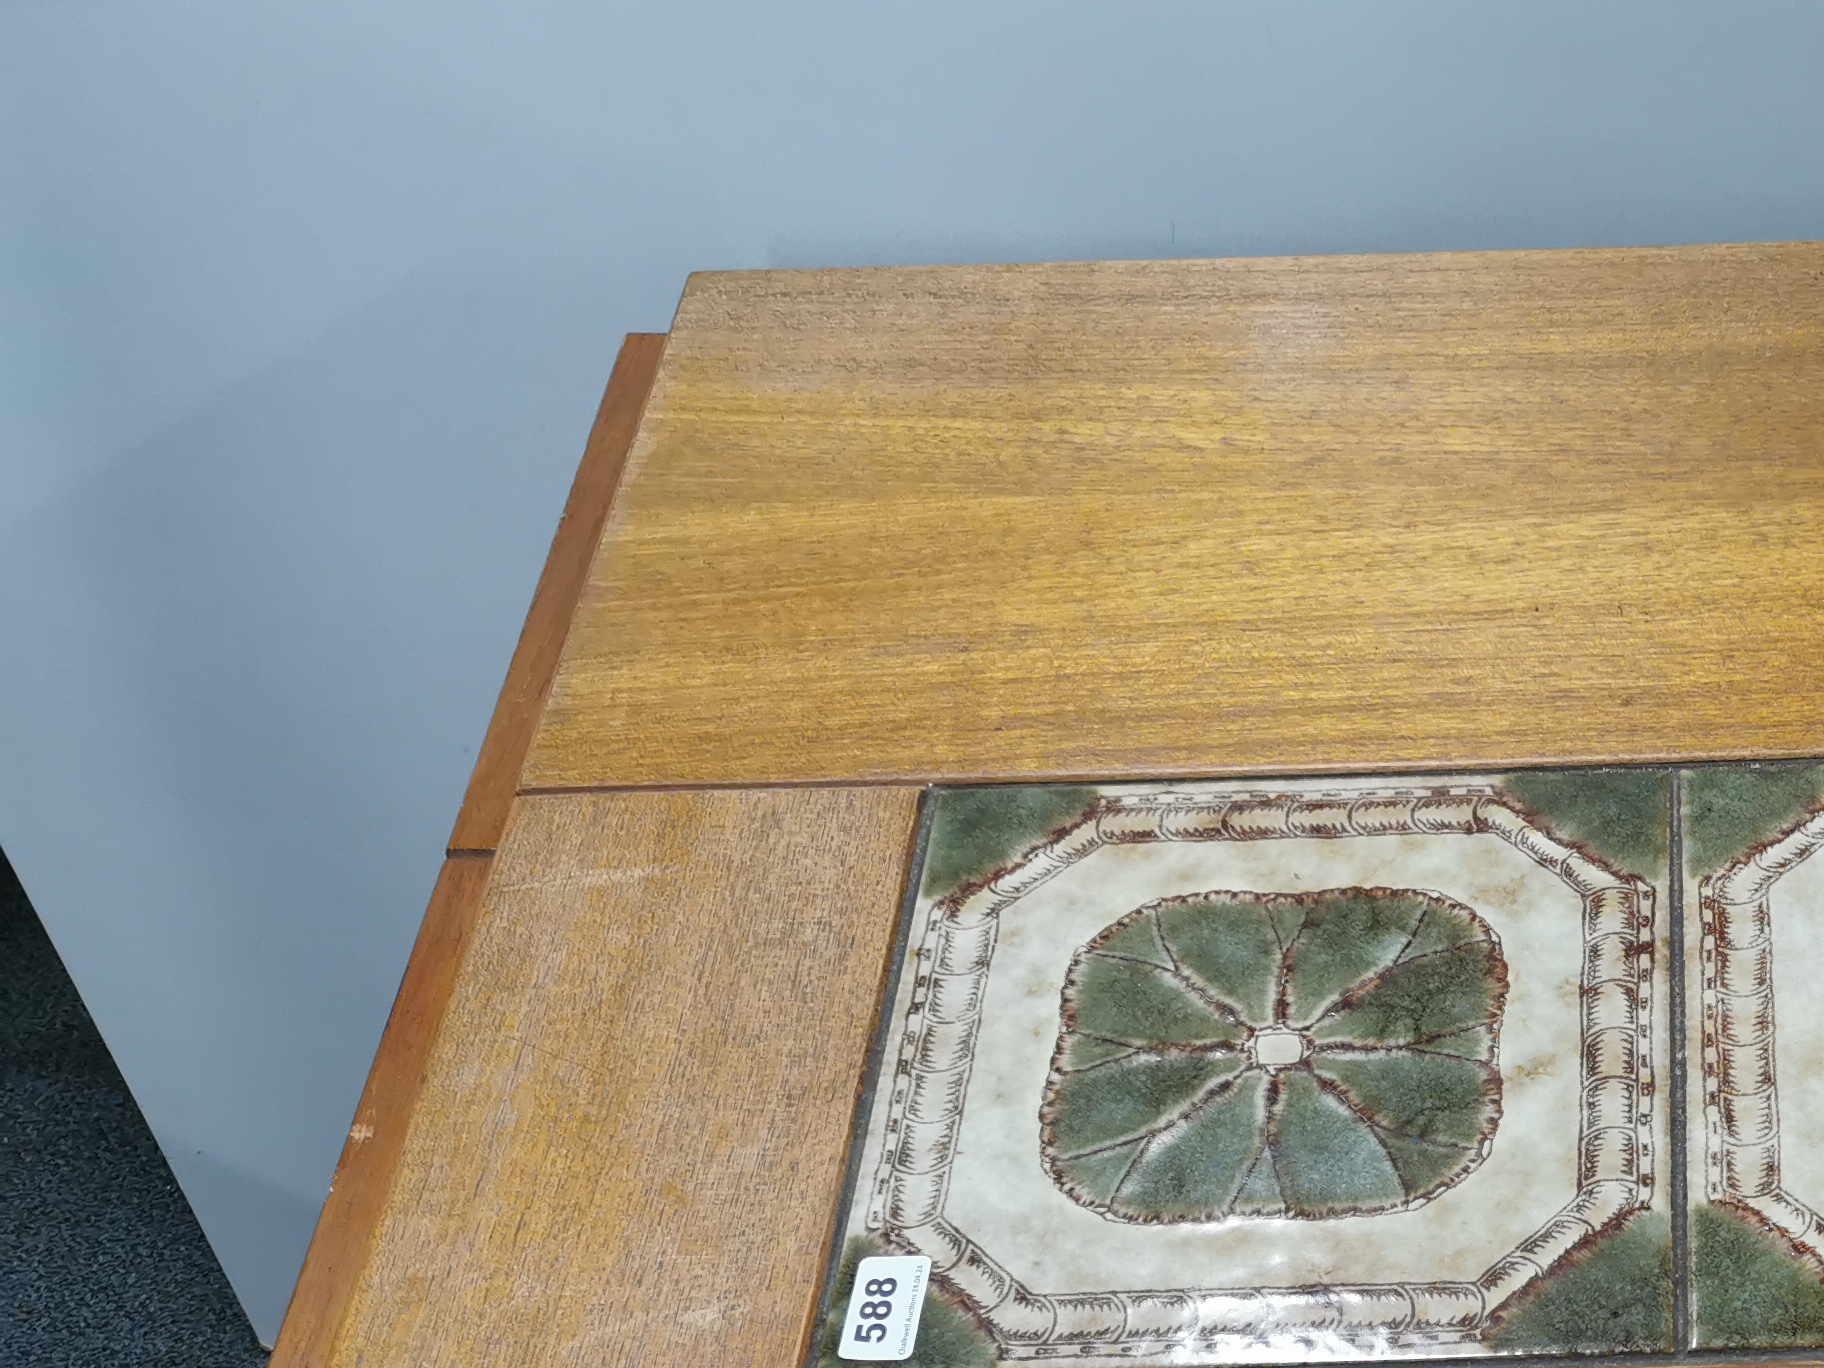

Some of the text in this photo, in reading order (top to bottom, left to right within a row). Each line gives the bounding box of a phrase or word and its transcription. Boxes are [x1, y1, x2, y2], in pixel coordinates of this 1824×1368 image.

[854, 1277, 898, 1344] 588
[898, 1323, 911, 1355] Chalkwell
[909, 1294, 918, 1322] Auctions
